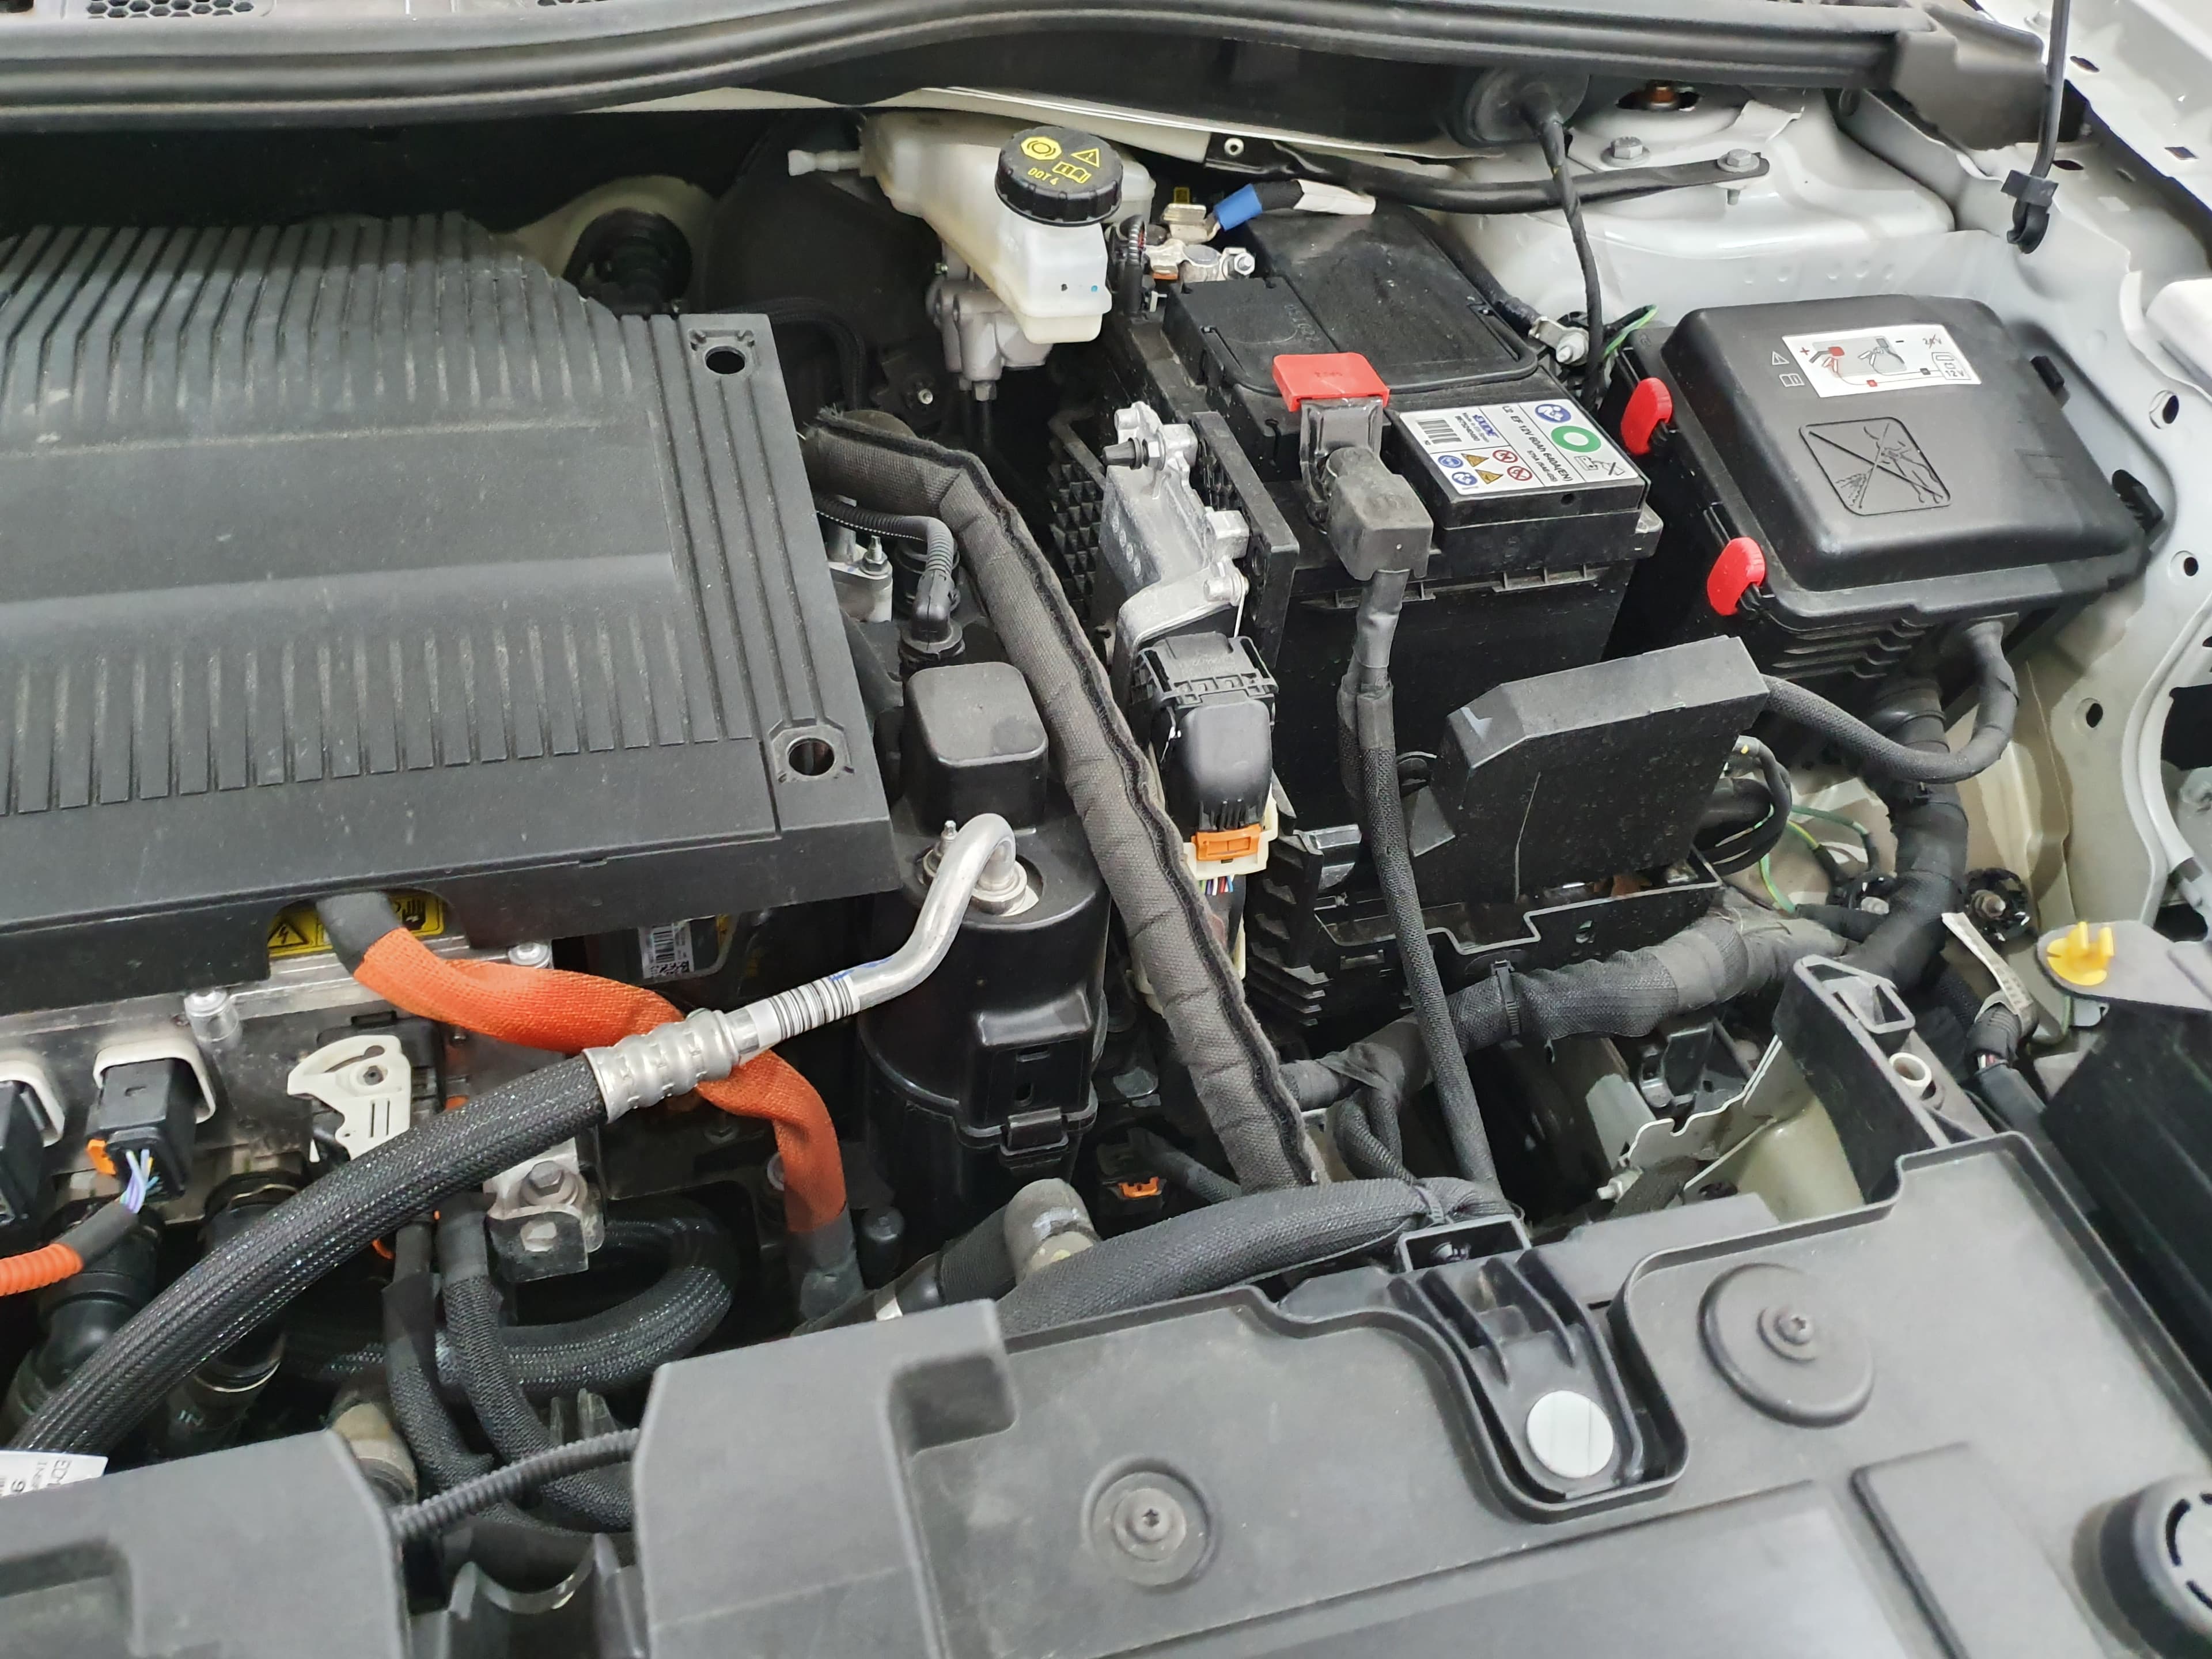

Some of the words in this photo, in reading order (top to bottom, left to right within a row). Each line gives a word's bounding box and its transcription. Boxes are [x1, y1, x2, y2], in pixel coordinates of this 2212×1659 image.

[1027, 167, 1052, 181] DOT
[1519, 425, 1534, 435] 12V
[1529, 437, 1546, 452] 60Ah
[1543, 453, 1573, 482] 640A(EN)
